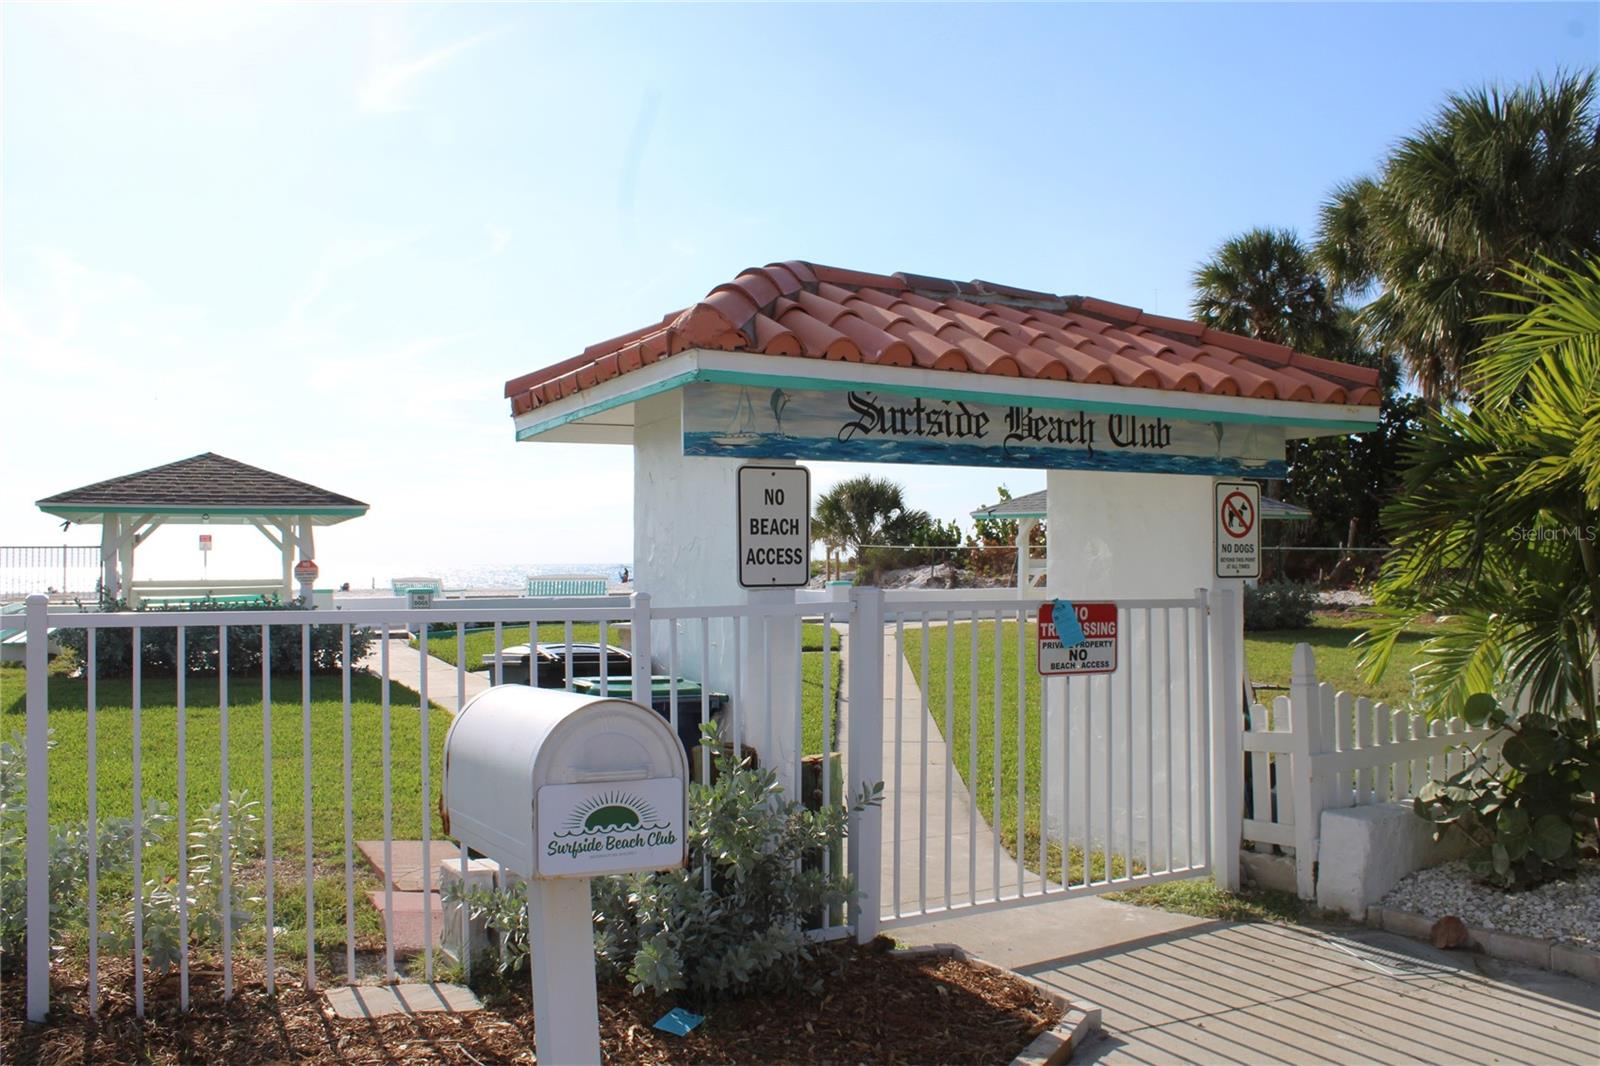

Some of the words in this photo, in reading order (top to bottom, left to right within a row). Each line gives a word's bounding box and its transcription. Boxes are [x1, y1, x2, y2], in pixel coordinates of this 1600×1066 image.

[1003, 406, 1096, 458] Beach
[764, 488, 785, 506] NO
[750, 518, 799, 535] BEACH
[746, 548, 803, 565] ACCESS
[1221, 543, 1232, 553] NO
[1234, 543, 1255, 553] DOGS
[1040, 621, 1116, 637] TRSSING
[1069, 649, 1088, 661] NO
[1050, 662, 1076, 670] BEACH
[1081, 660, 1110, 669] ACCESS
[547, 837, 604, 859] Surfside
[605, 833, 645, 851] Beach
[647, 830, 677, 847] Club
